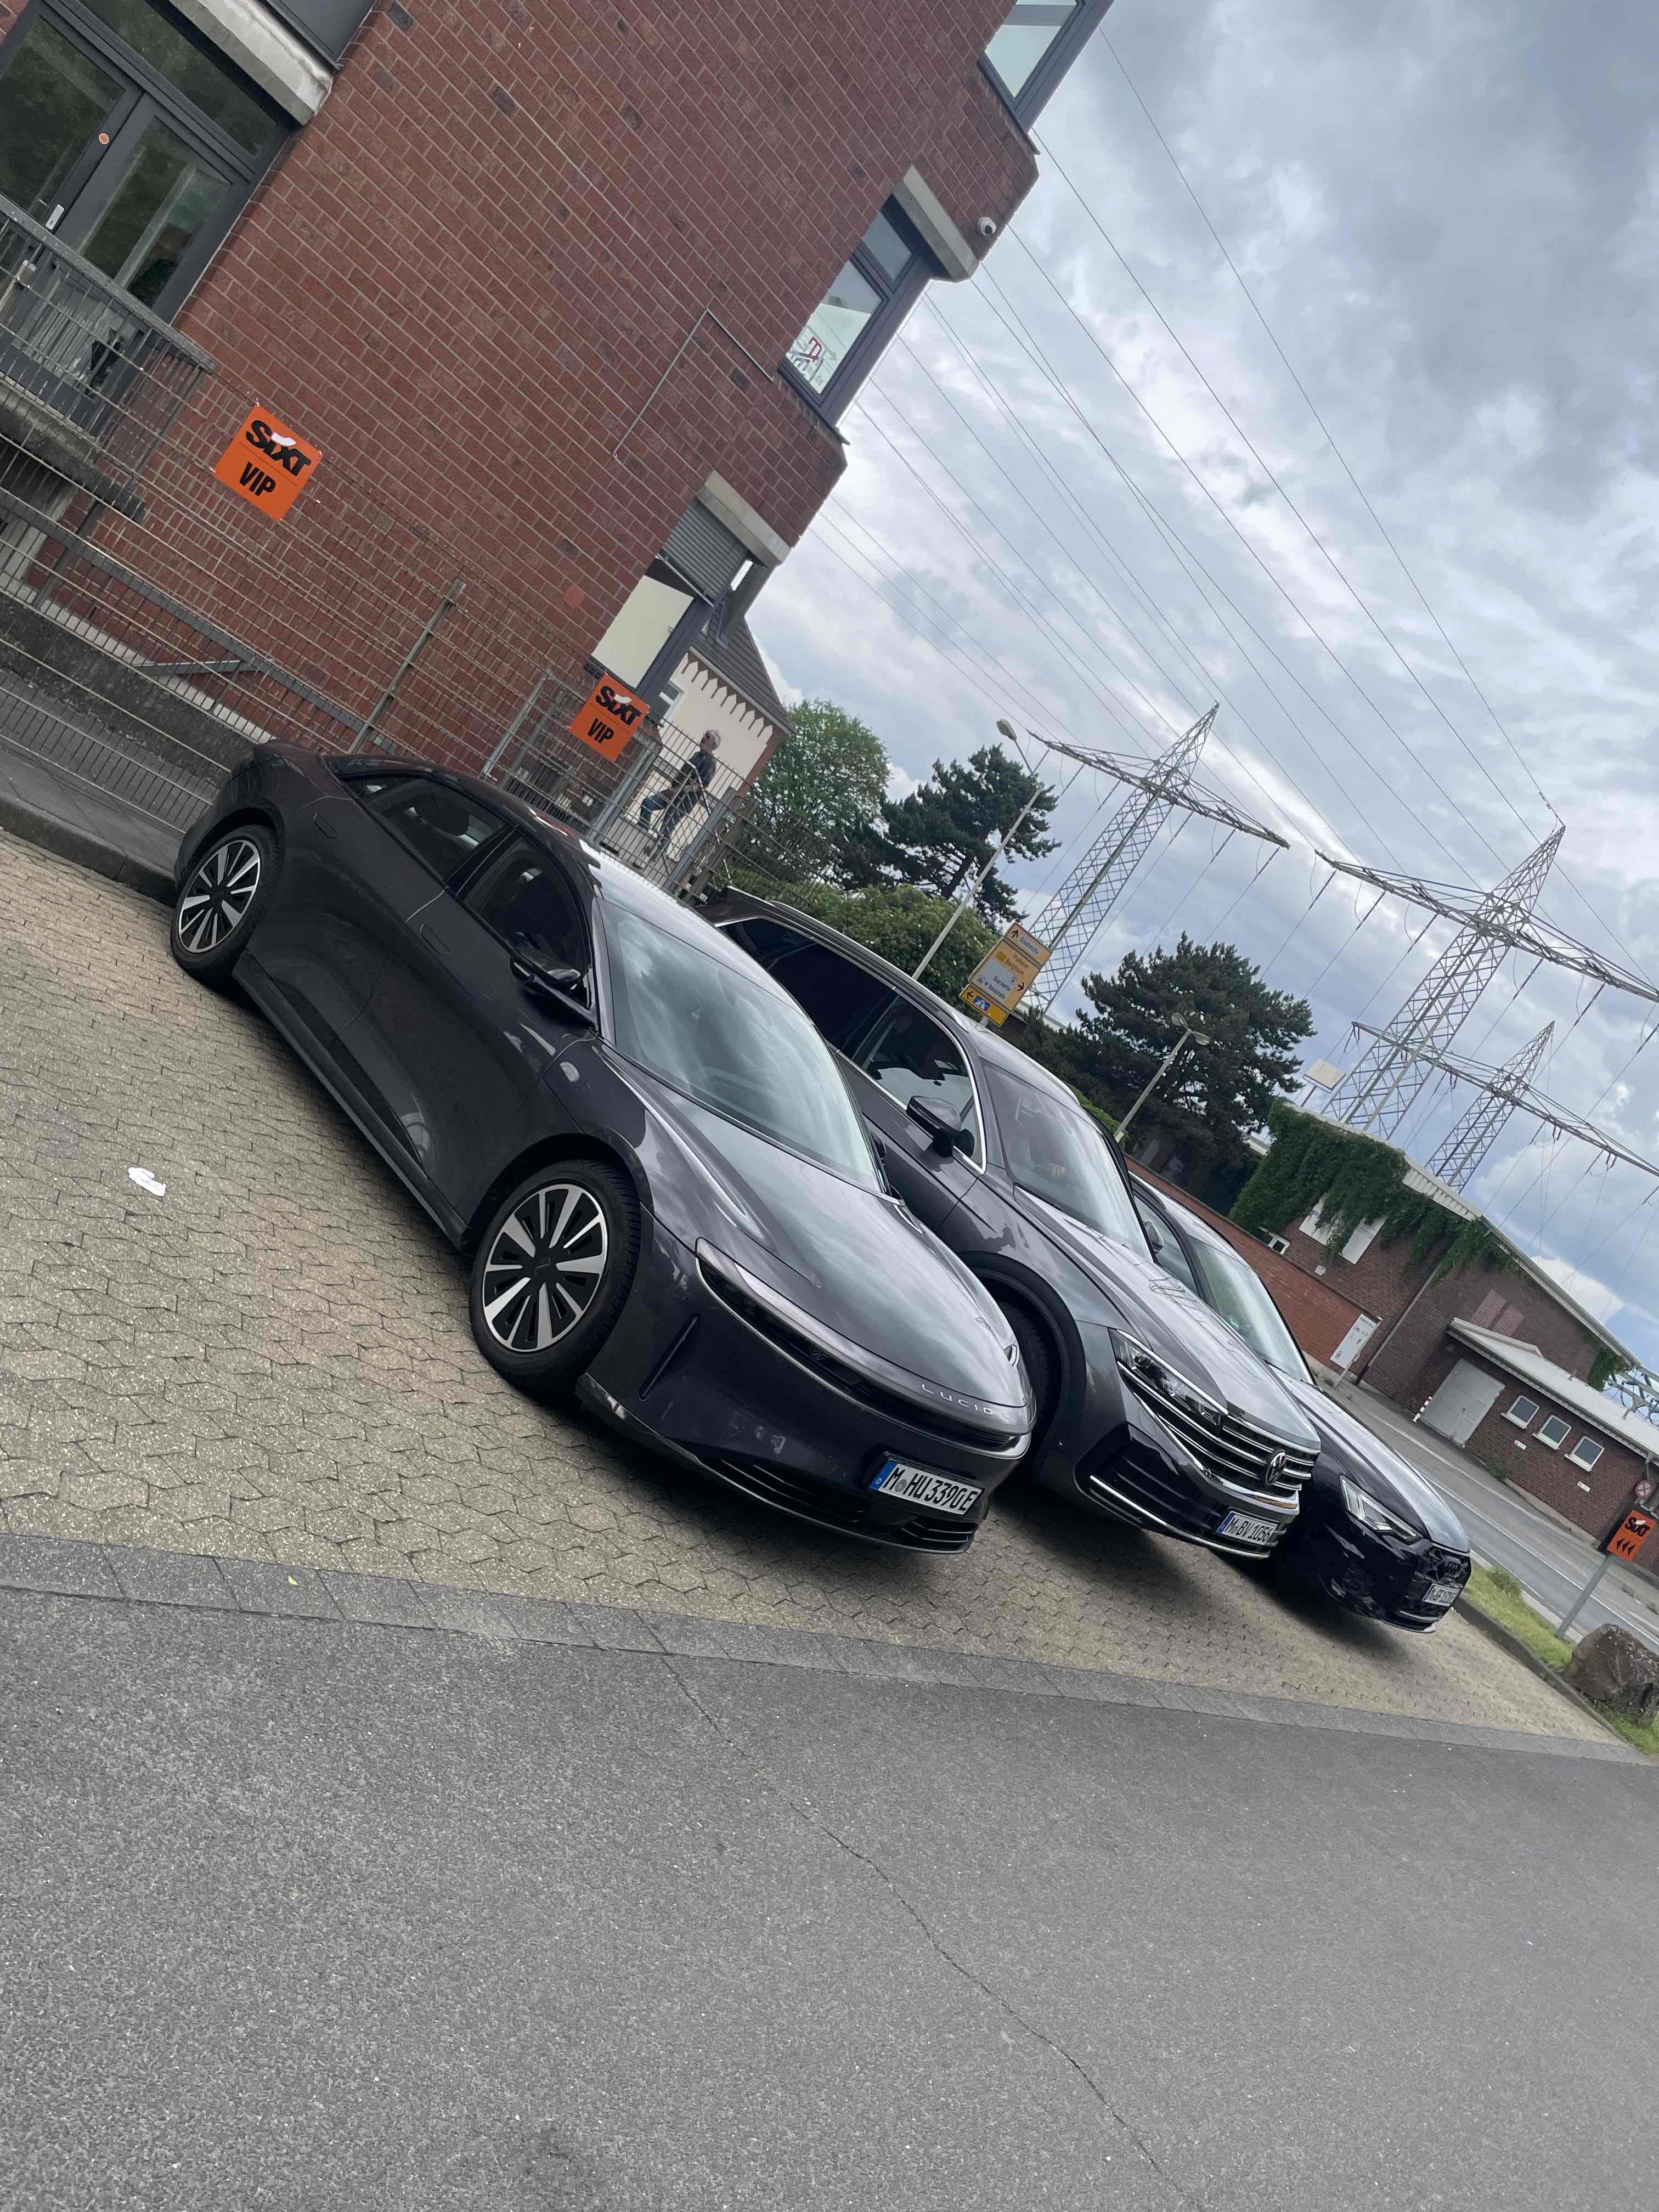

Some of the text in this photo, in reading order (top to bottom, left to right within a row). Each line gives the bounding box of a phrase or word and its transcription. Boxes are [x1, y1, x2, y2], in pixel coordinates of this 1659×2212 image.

[239, 461, 276, 496] VIP
[588, 718, 614, 743] VIP
[921, 1383, 992, 1415] LUCID
